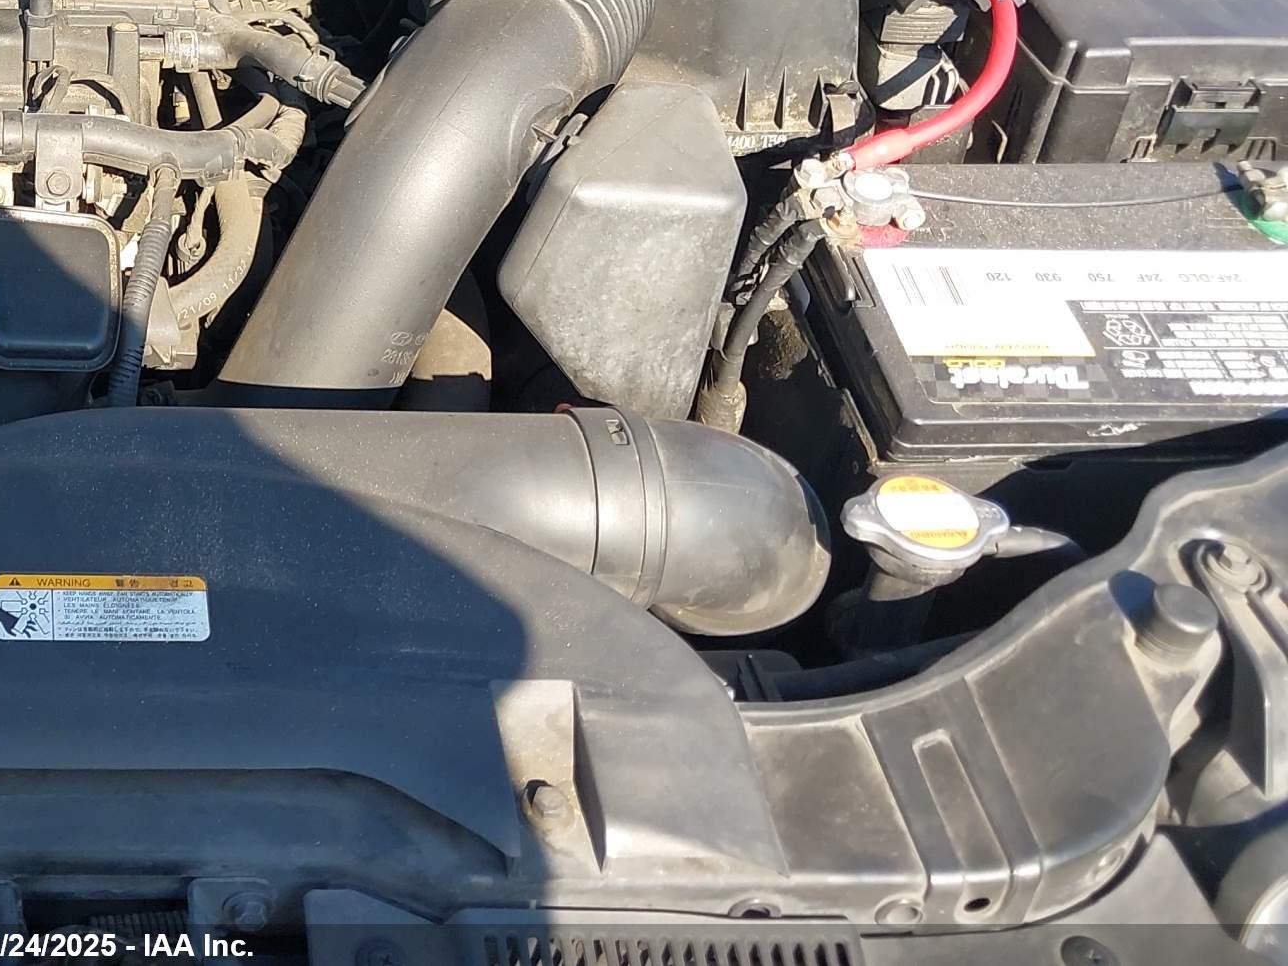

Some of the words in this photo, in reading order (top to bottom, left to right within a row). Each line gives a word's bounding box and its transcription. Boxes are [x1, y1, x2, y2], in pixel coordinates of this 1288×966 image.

[986, 271, 1012, 282] 120
[1035, 271, 1062, 282] 930
[1087, 272, 1115, 283] 750
[1136, 272, 1163, 283] 24F
[950, 365, 1090, 391] Duralast
[36, 578, 91, 587] WARNING
